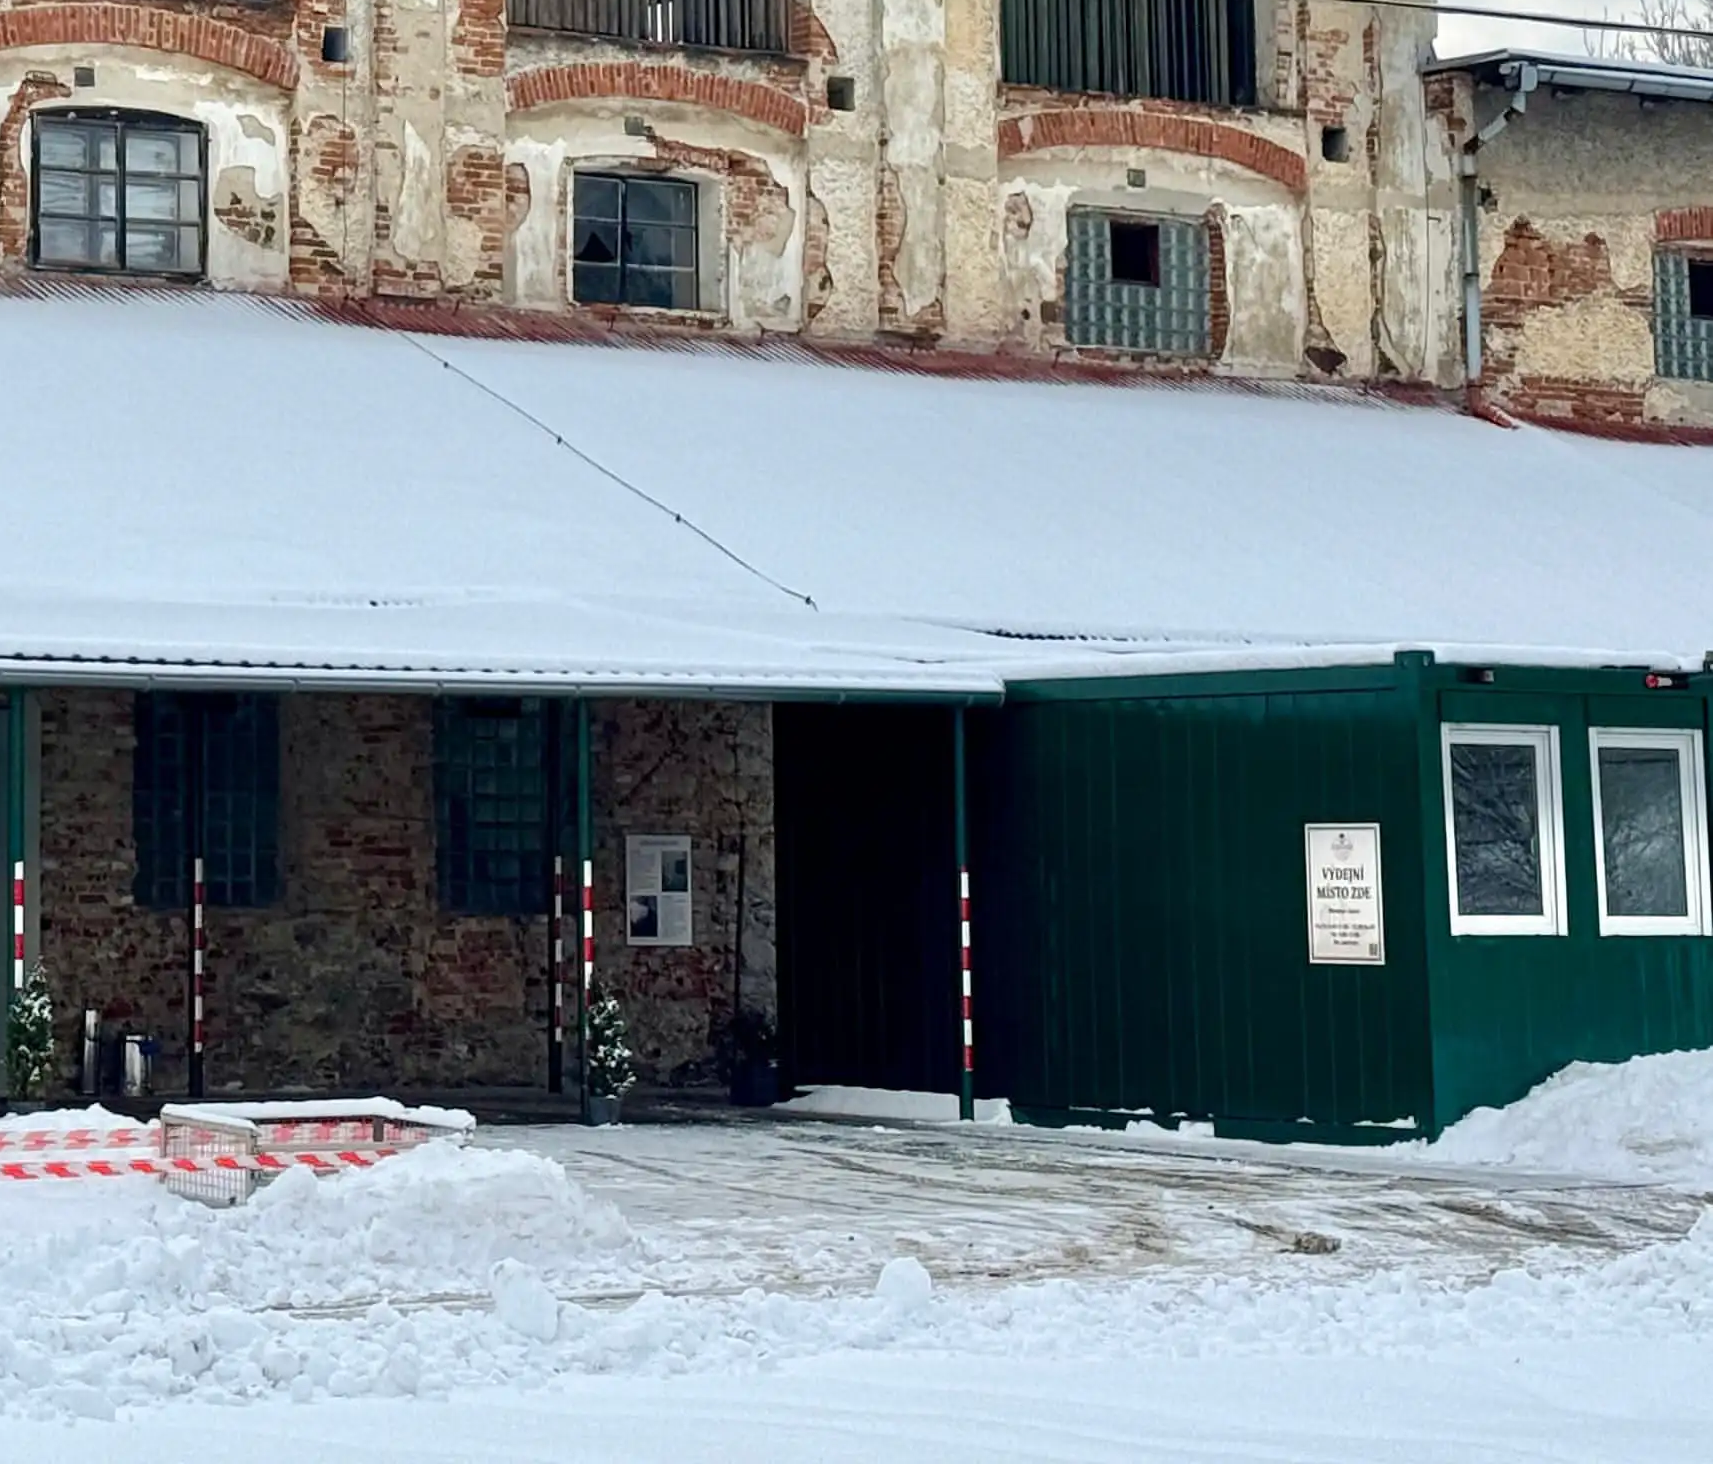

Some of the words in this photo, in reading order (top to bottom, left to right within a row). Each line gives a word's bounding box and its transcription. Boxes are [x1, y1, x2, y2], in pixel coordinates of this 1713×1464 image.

[1322, 863, 1364, 883] VÝDEJNÍ
[1317, 883, 1349, 899] MÍSTO
[1351, 886, 1371, 900] ZDE
